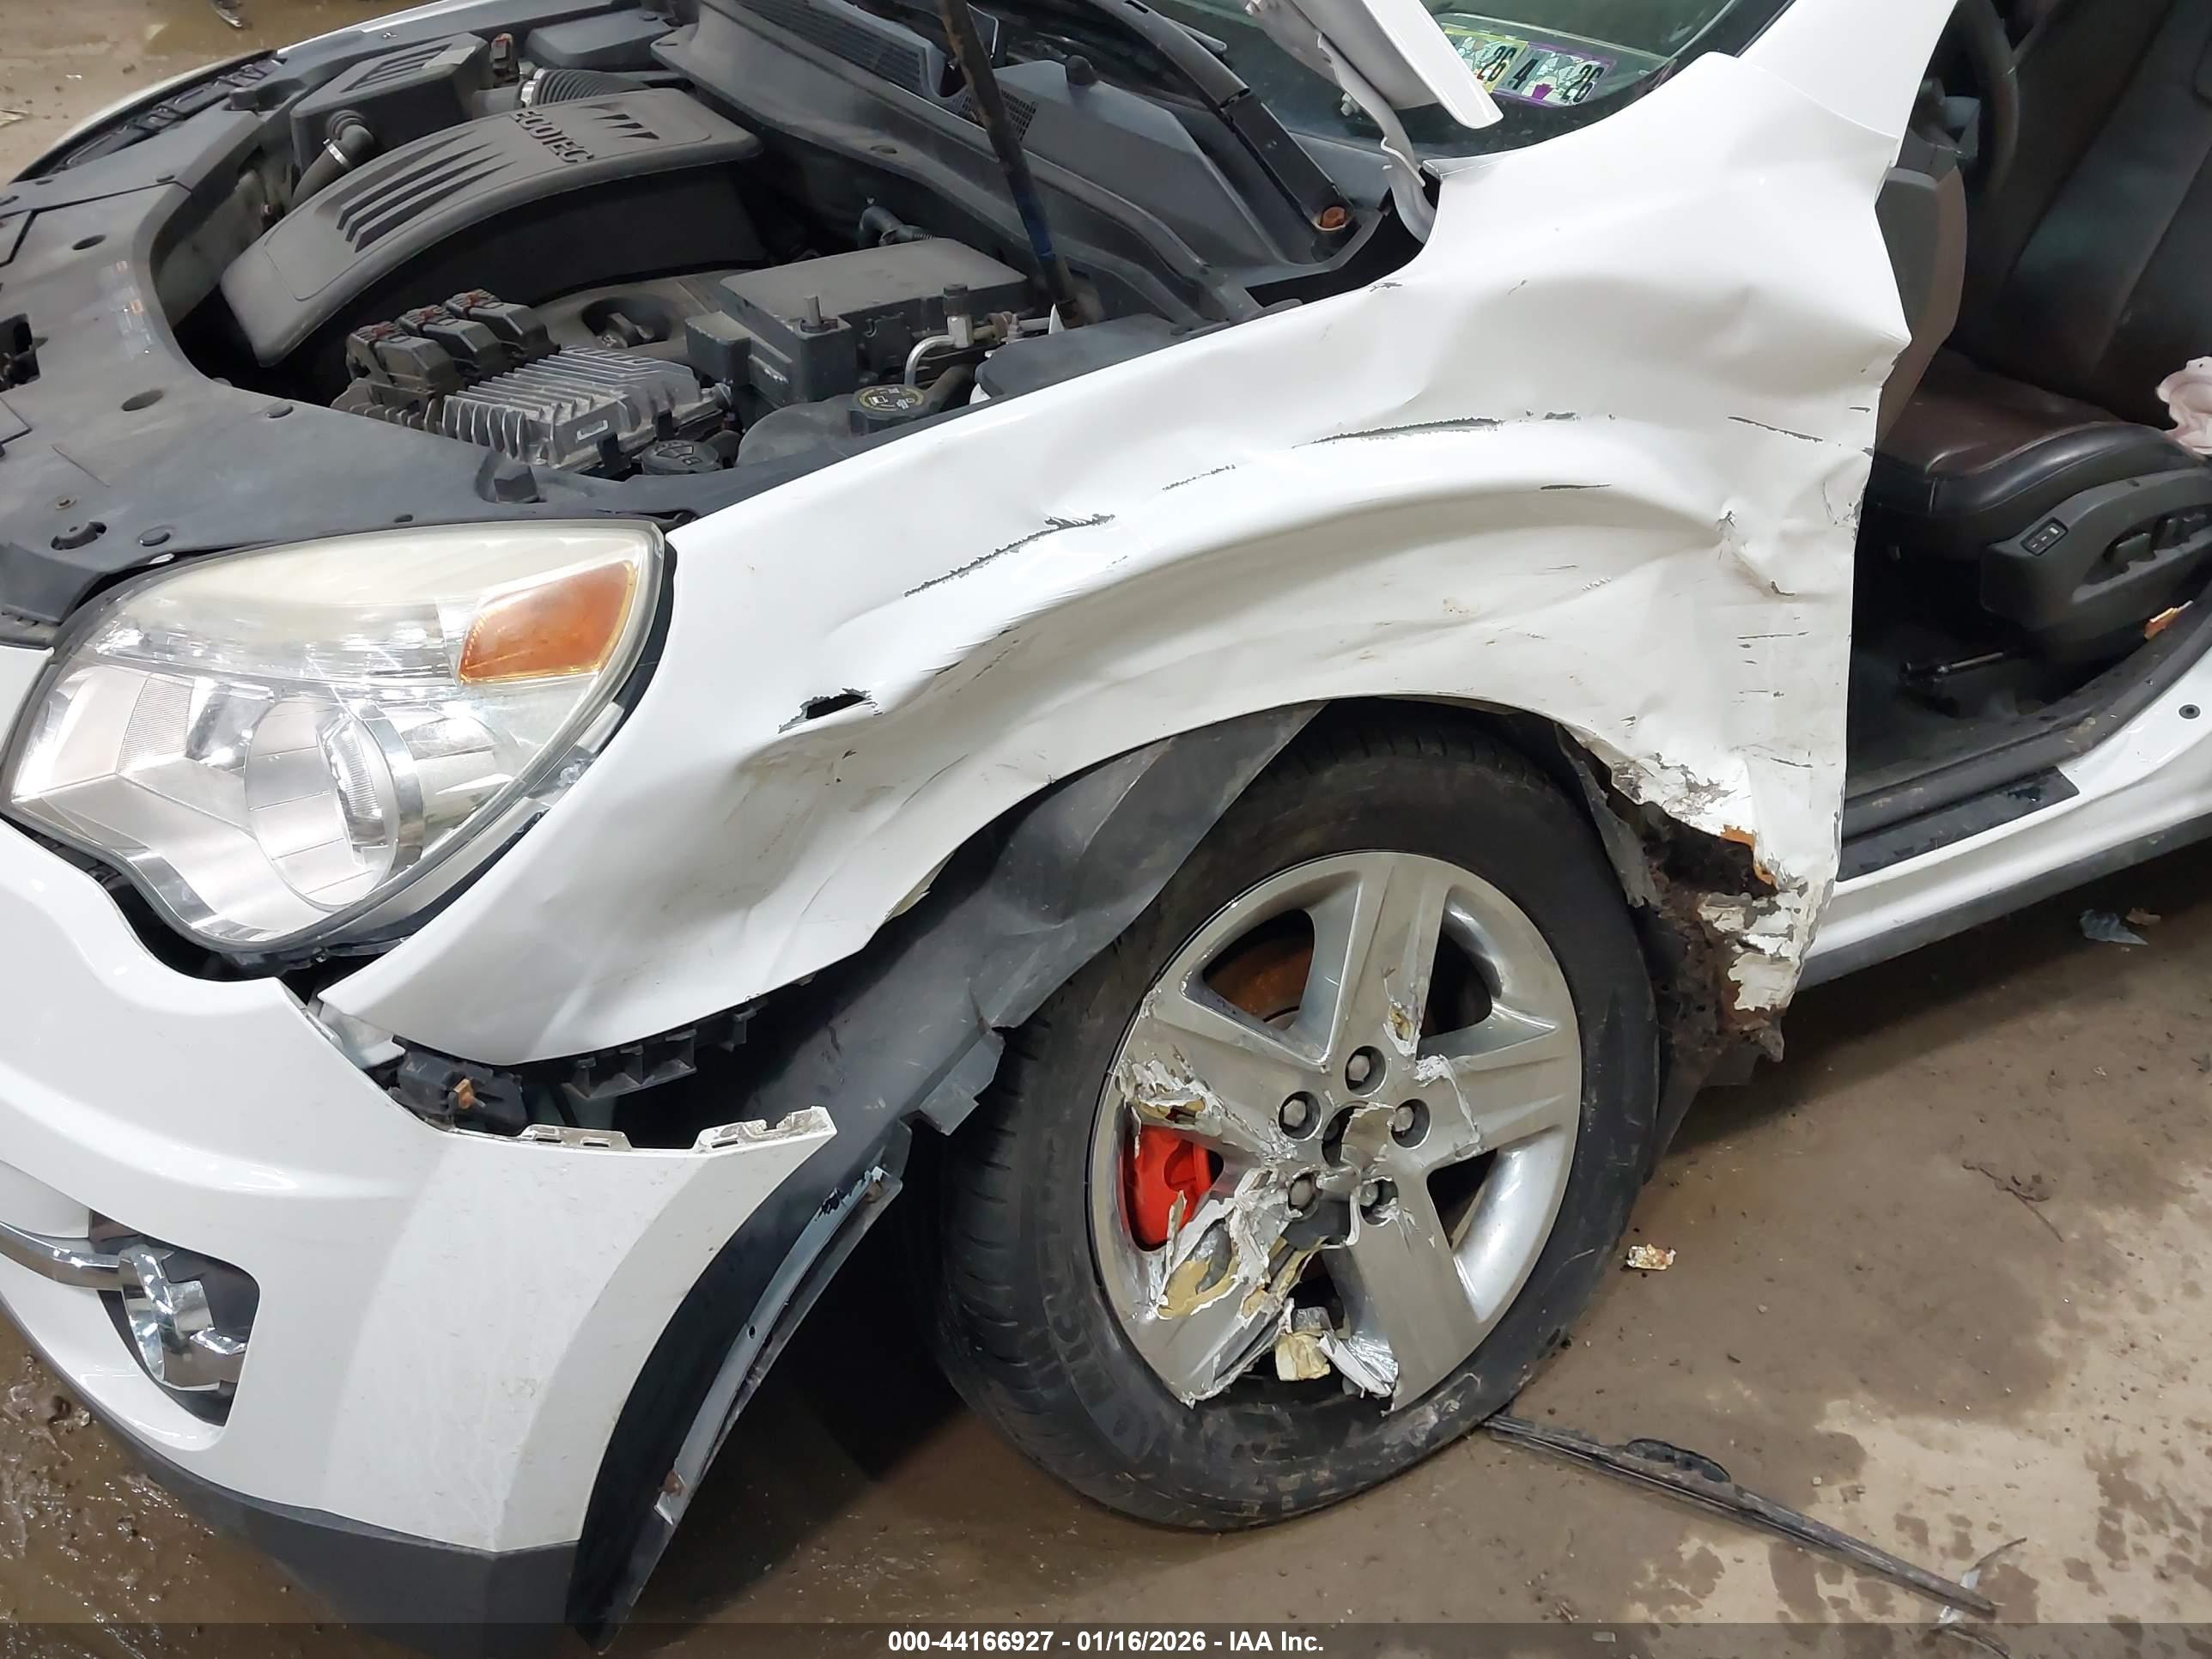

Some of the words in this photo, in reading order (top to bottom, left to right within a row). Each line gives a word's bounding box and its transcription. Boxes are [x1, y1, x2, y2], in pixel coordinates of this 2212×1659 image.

[1476, 45, 1517, 82] 26
[1512, 58, 1540, 90] 4
[1559, 64, 1605, 103] 26
[509, 110, 594, 163] ECOTEC
